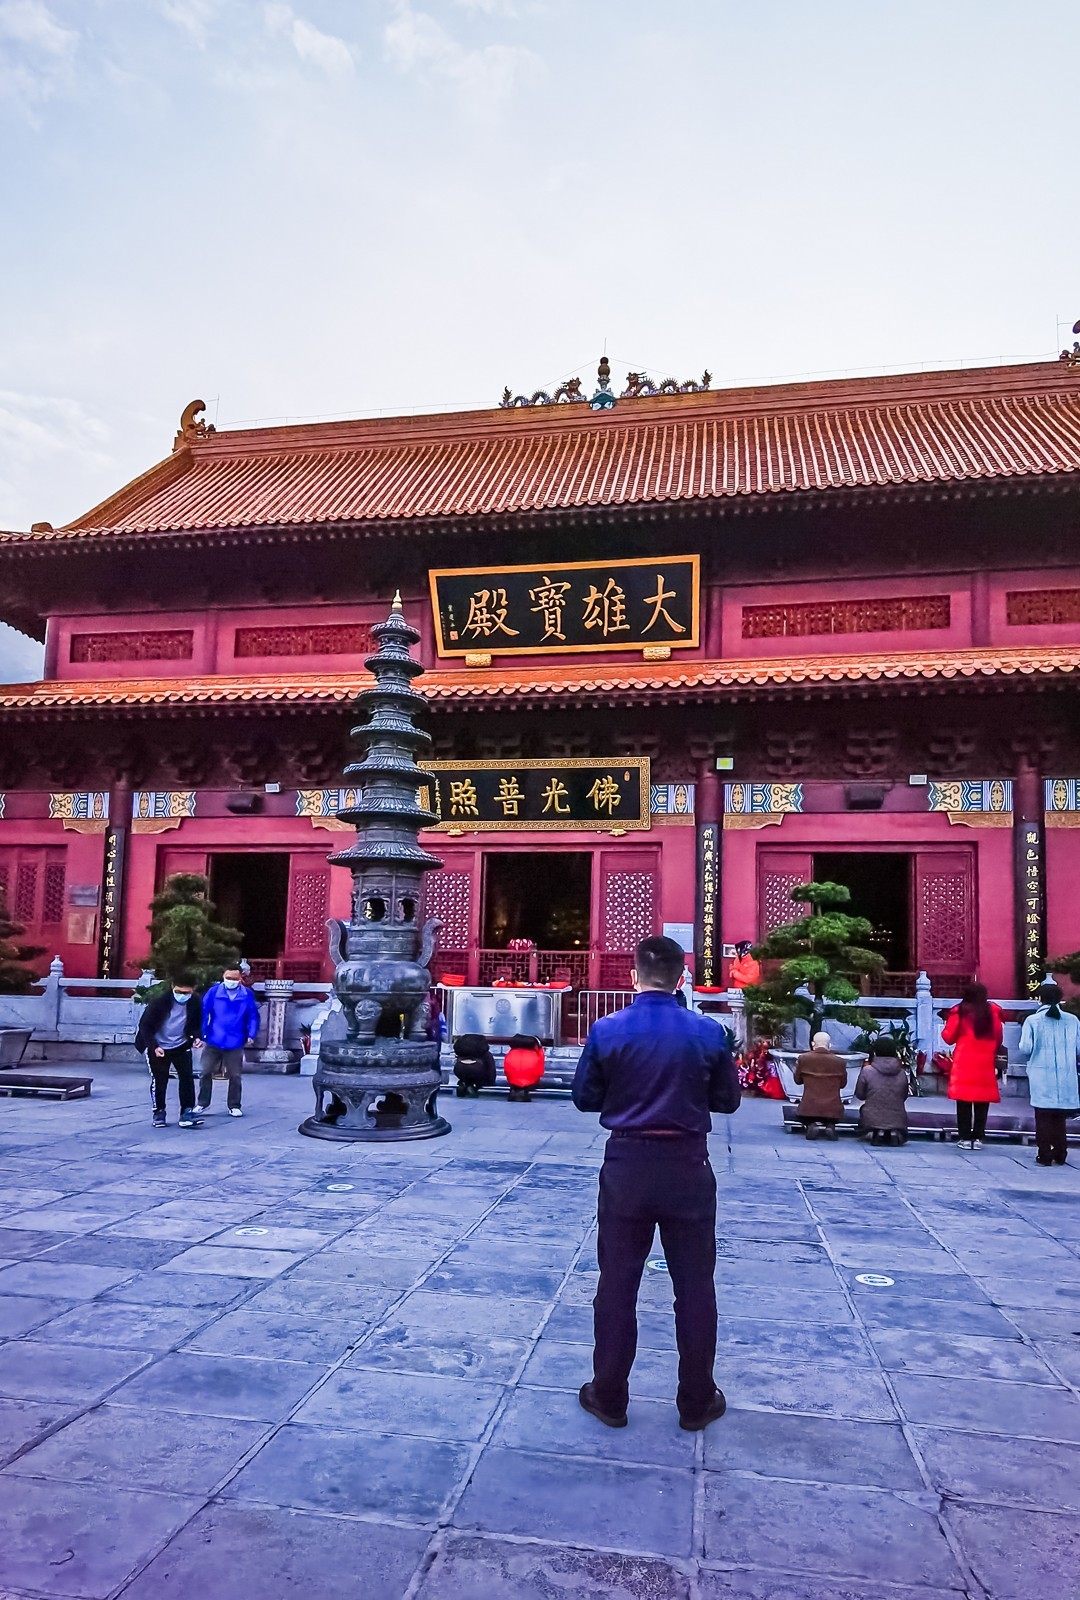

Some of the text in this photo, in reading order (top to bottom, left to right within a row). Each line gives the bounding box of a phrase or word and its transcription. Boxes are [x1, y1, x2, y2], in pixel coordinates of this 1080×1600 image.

[461, 574, 686, 642] 大雄寶殿
[450, 775, 622, 816] 佛光普照
